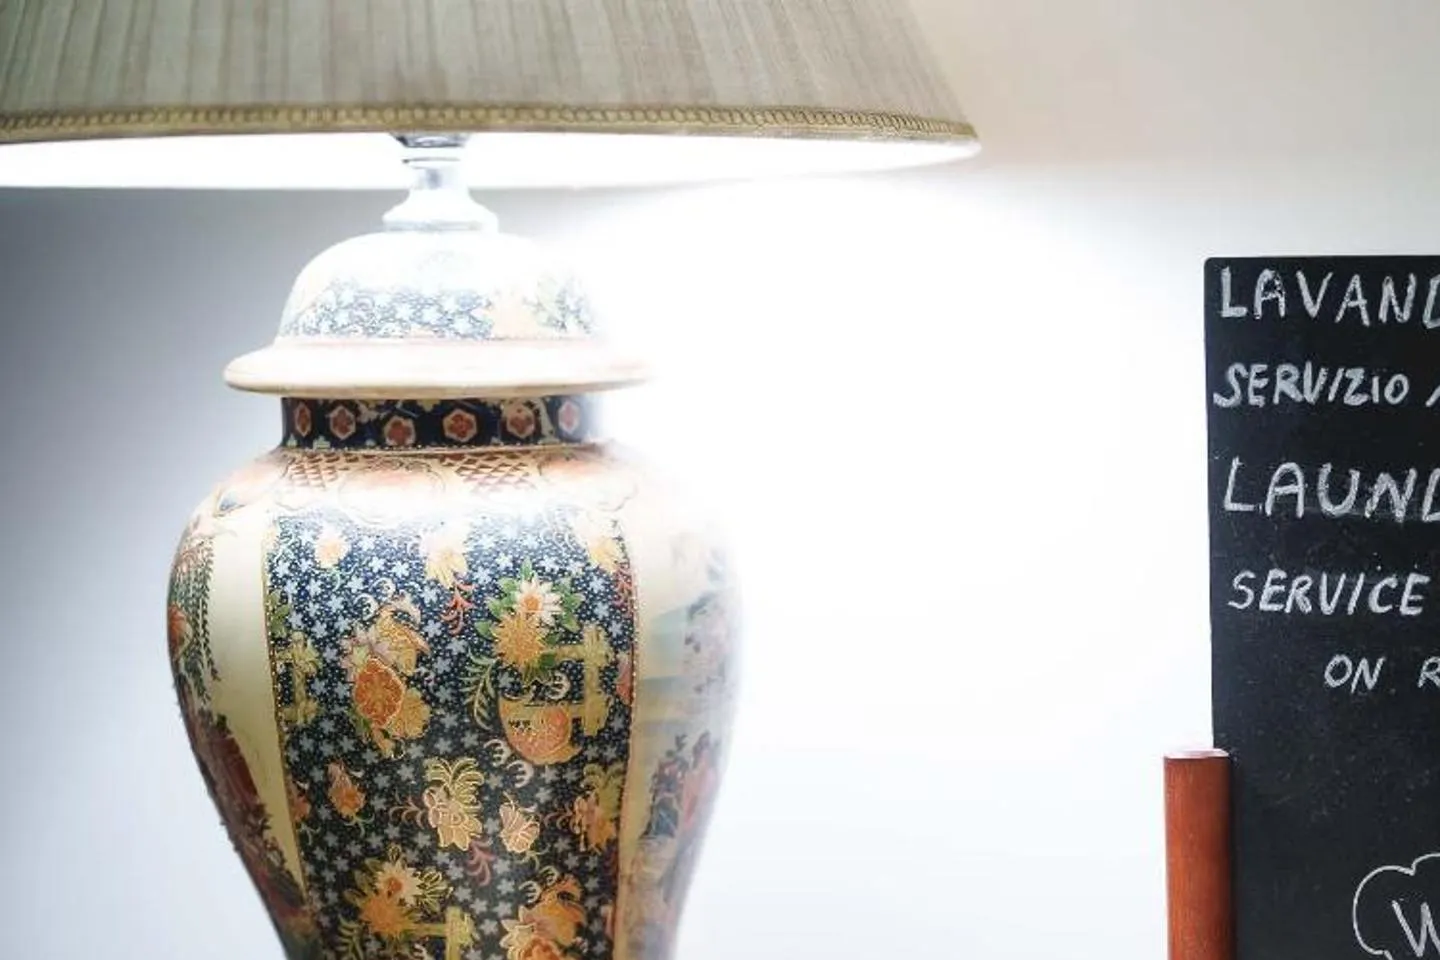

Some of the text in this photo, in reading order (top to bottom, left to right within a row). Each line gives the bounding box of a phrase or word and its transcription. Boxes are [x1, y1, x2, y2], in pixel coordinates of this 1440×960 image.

[1213, 360, 1410, 409] SERVIZIO
[1228, 568, 1432, 617] SERVICE
[1323, 653, 1387, 693] ON
